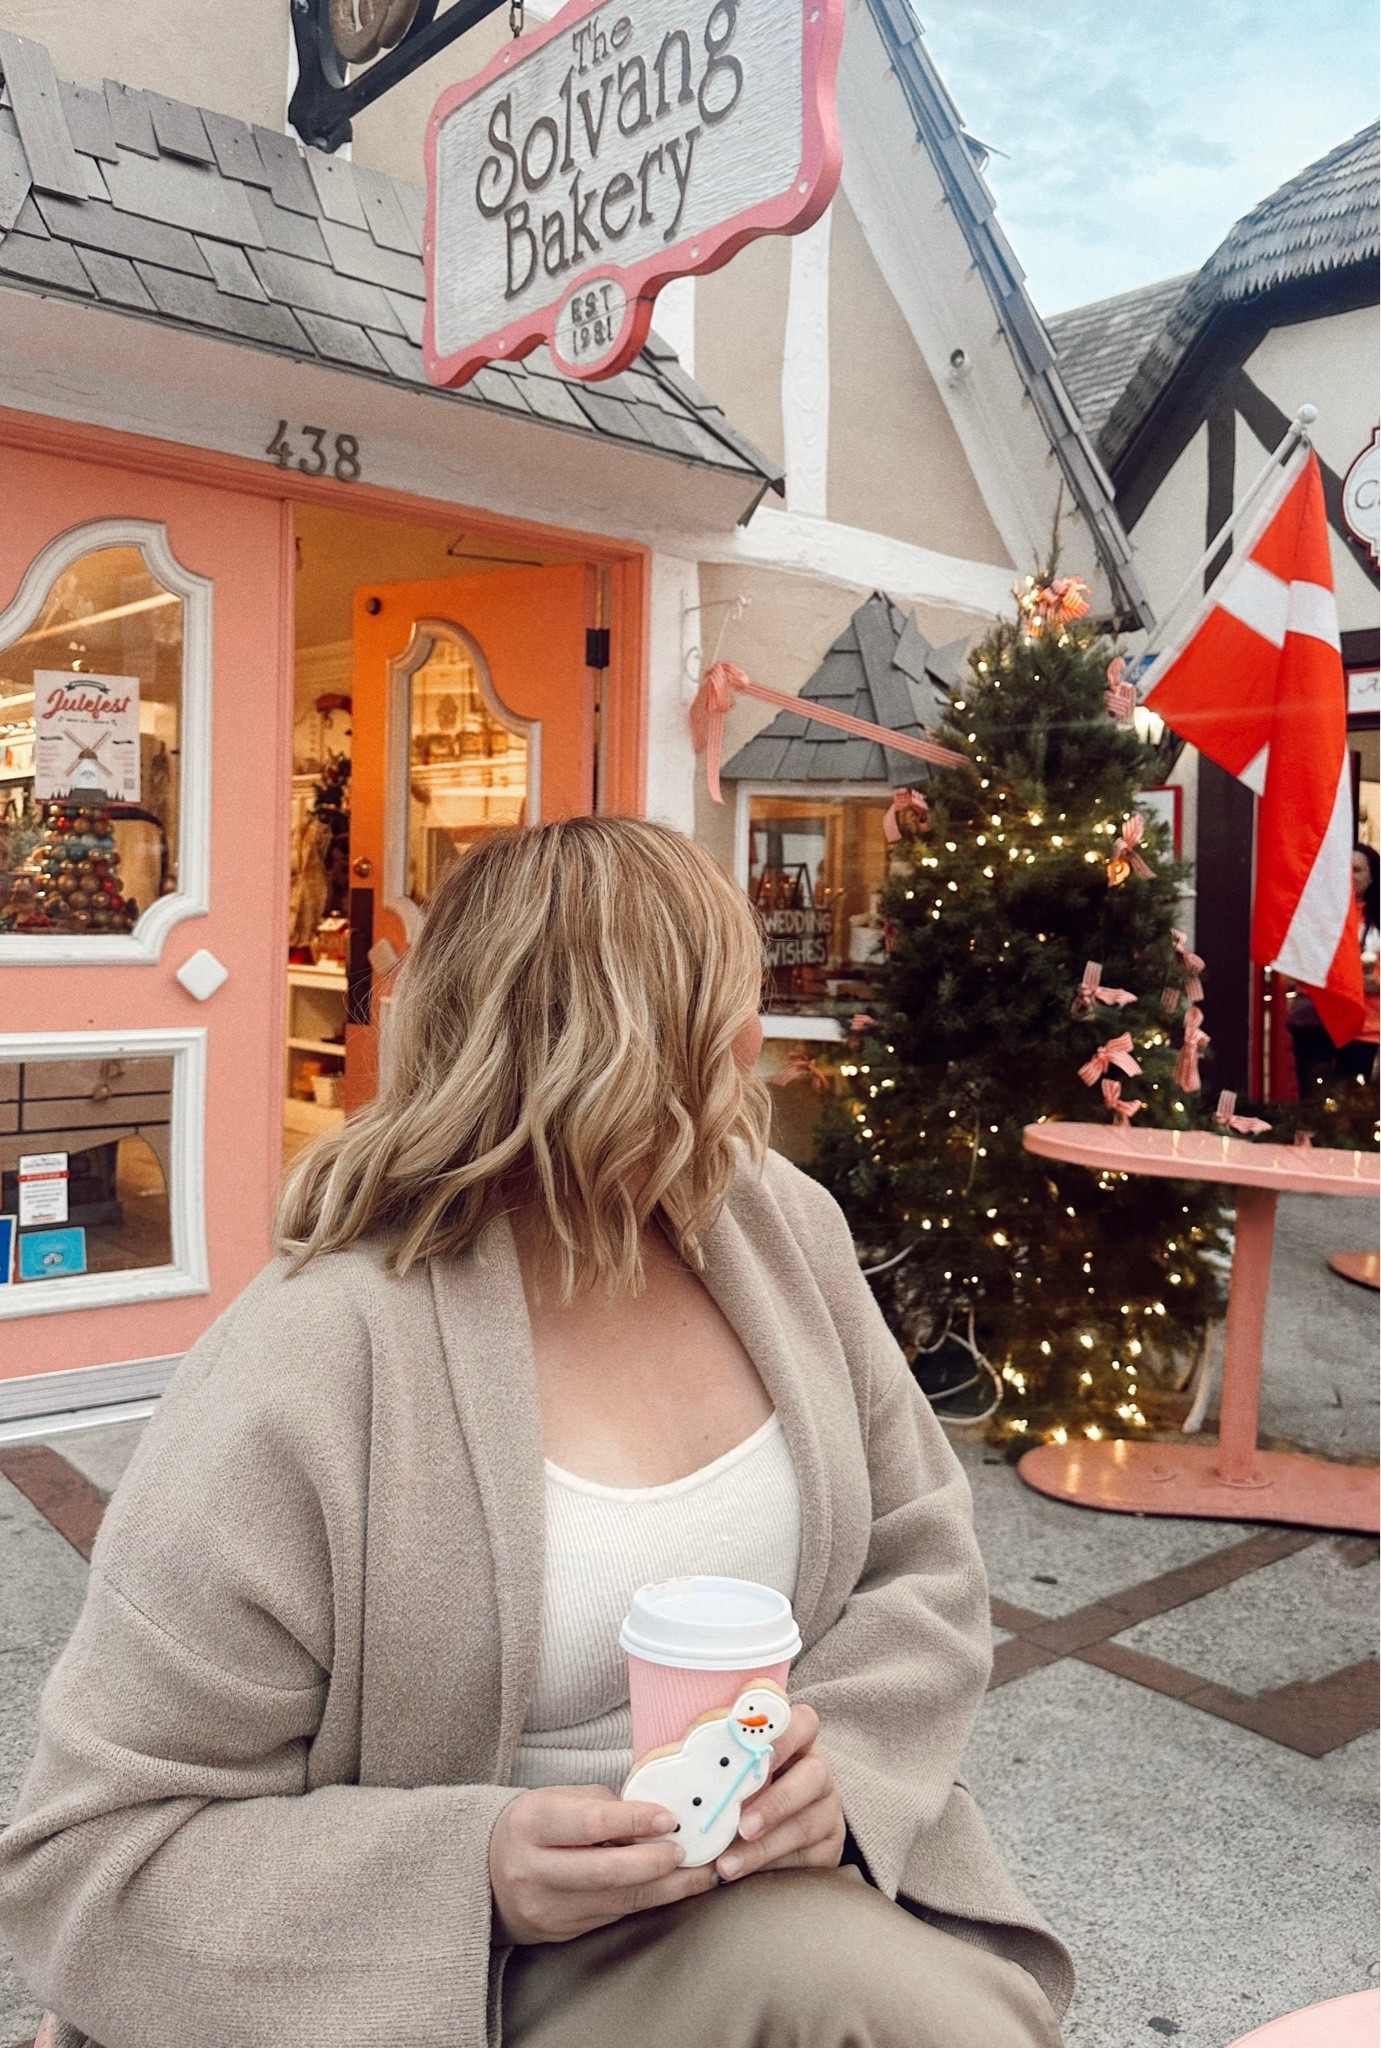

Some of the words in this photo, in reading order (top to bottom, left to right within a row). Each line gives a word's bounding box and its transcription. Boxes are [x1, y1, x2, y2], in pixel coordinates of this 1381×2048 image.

[572, 15, 632, 75] The
[475, 0, 743, 218] Solvang
[503, 126, 701, 300] Bakery
[571, 283, 612, 323] EST
[572, 315, 613, 356] 1981
[266, 419, 361, 483] 438
[41, 688, 131, 720] Julefest
[761, 909, 833, 934] WEDDING
[761, 937, 826, 967] WISHES
